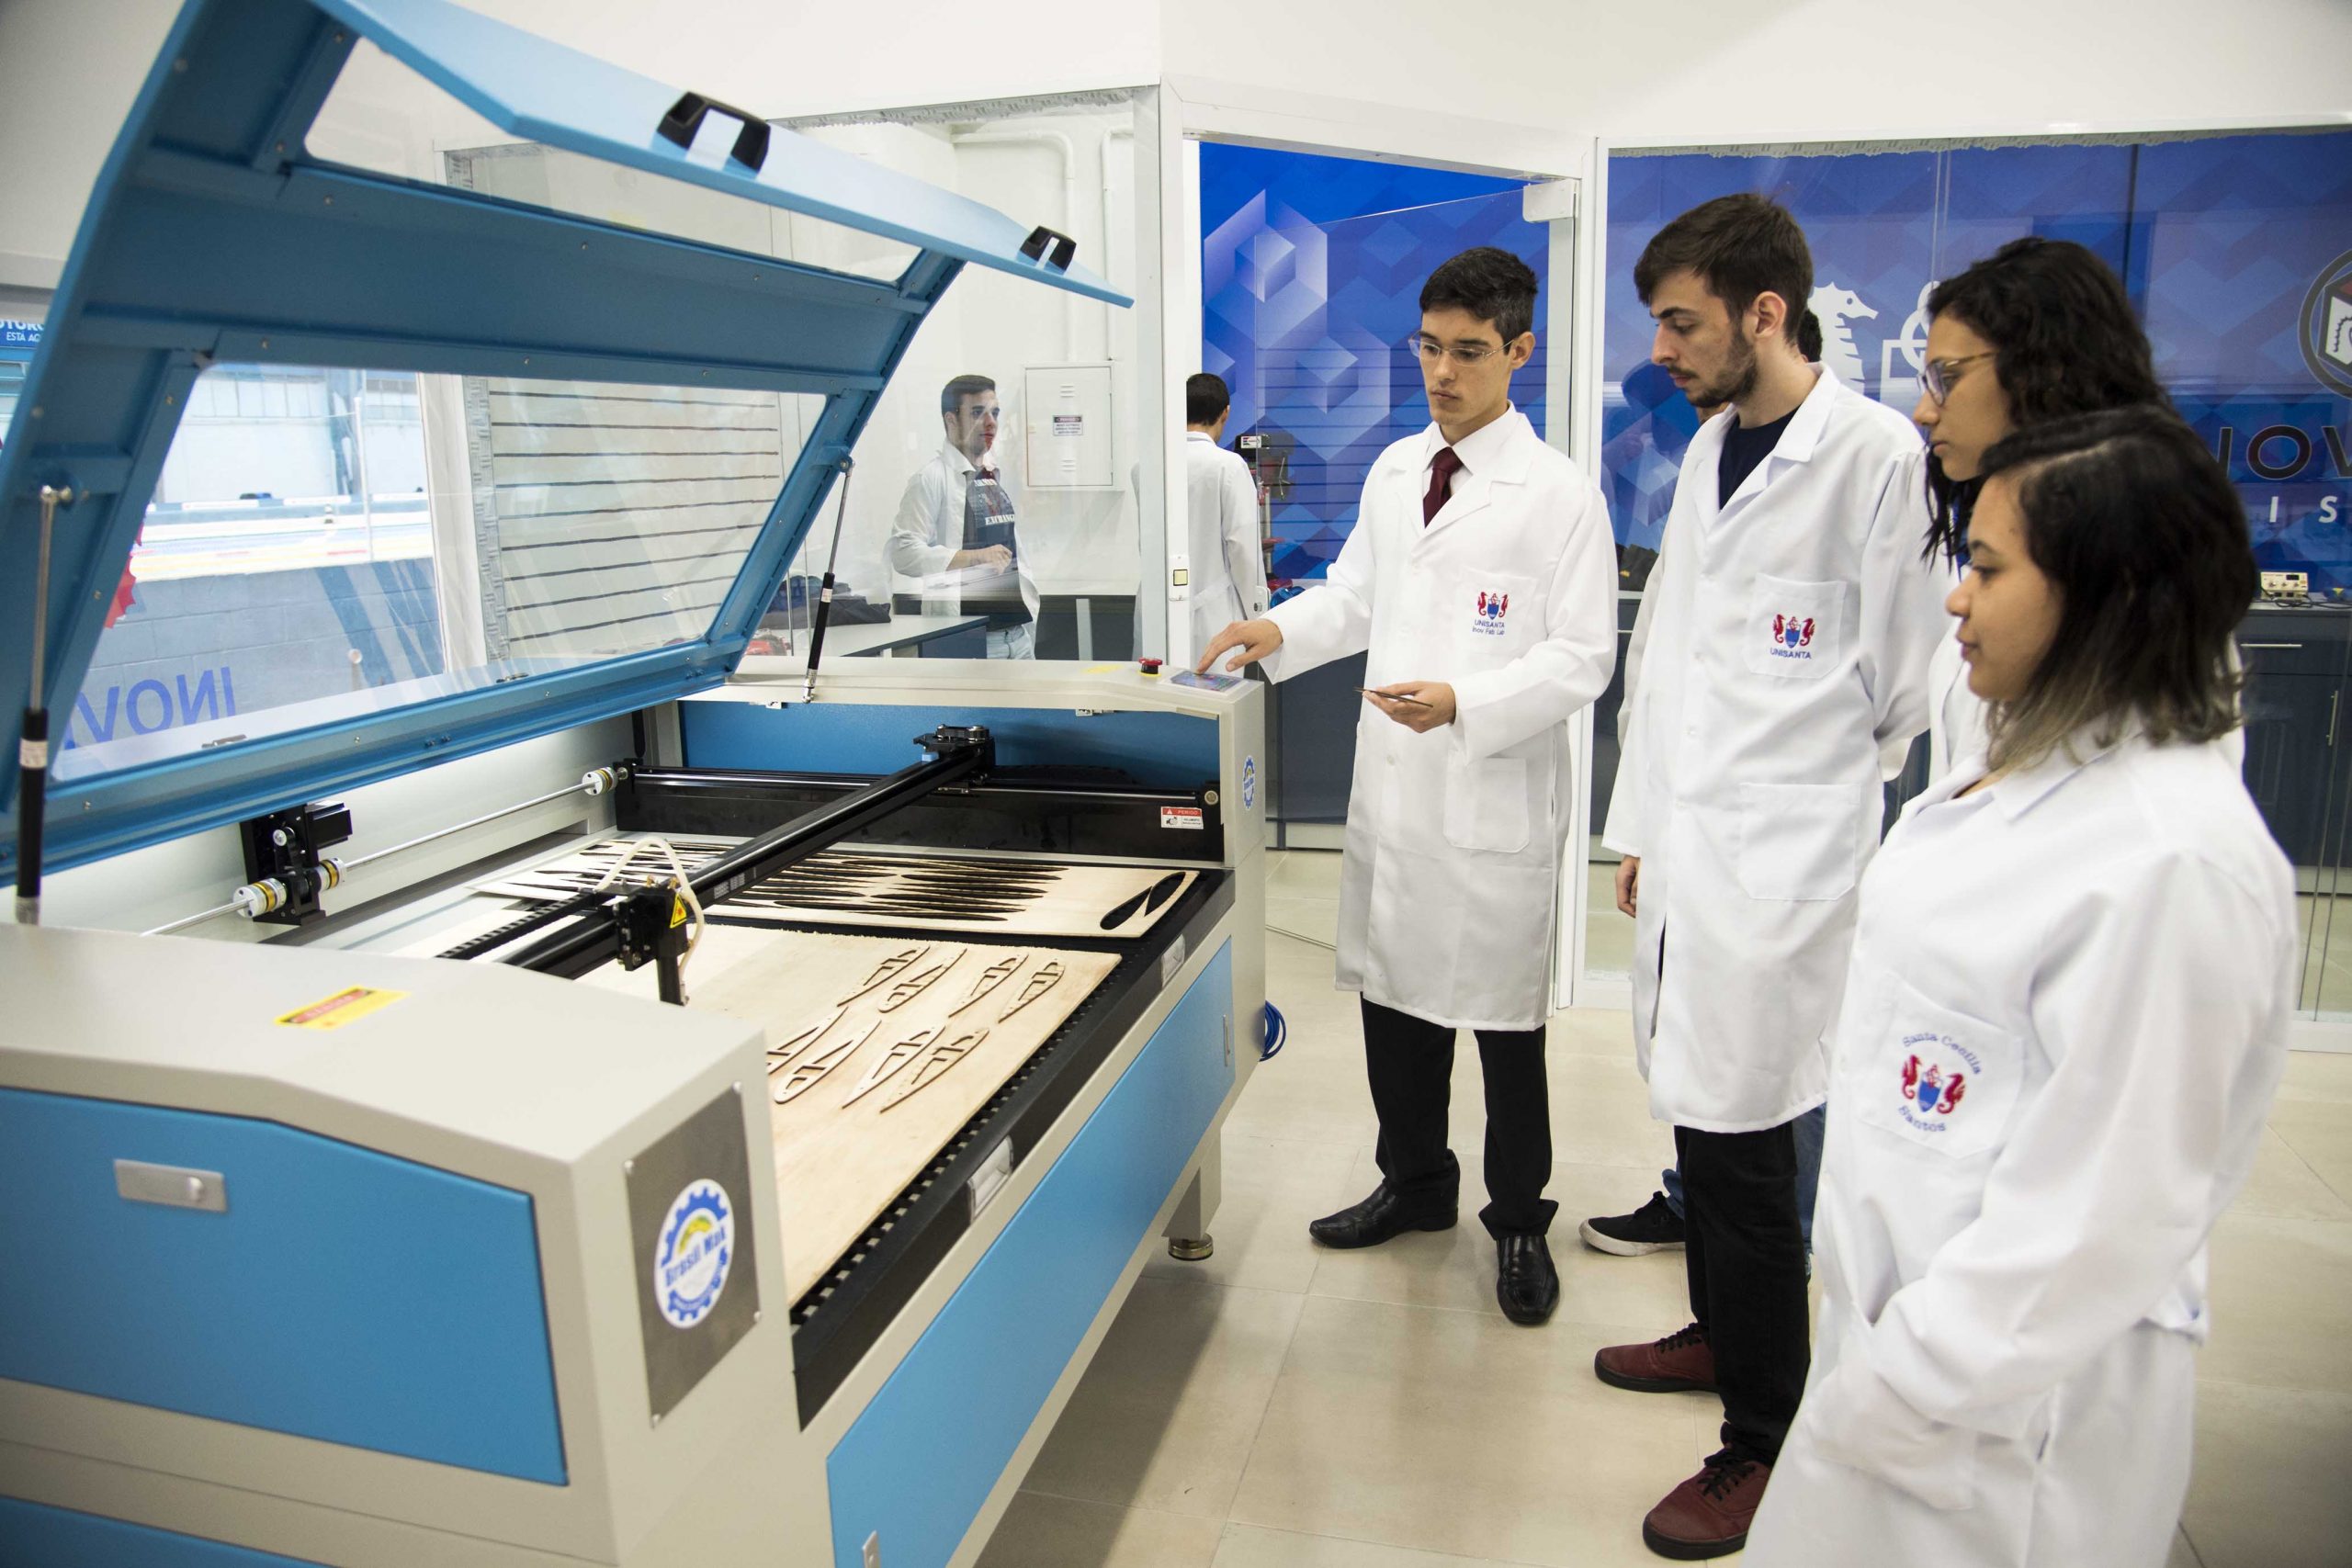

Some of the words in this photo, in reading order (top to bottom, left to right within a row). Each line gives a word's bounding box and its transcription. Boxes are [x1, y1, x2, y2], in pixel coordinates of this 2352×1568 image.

[1475, 619, 1505, 628] UNISANTA
[1770, 648, 1812, 660] UNISANTA
[1902, 1032, 1939, 1047] Santa
[1897, 1105, 1947, 1132] Santos
